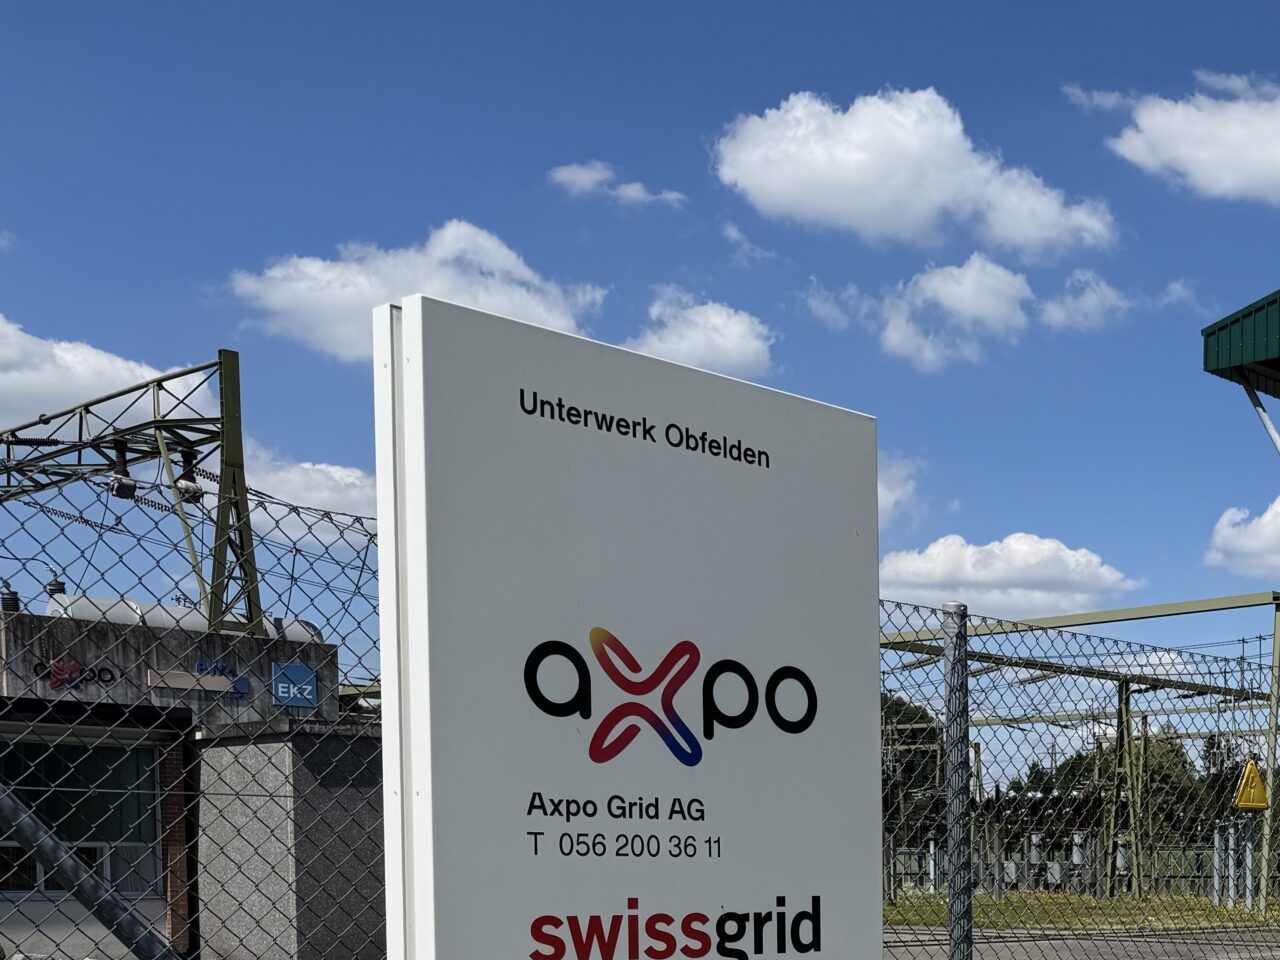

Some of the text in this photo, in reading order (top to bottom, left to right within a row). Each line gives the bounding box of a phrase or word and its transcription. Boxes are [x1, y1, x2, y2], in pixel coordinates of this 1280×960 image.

[520, 389, 770, 468] Unterwerk Obfelden
[278, 683, 313, 699] EKZ
[524, 627, 817, 767] axpo
[527, 792, 705, 822] Axpo Grid AG
[527, 832, 721, 858] T 056 200 36 11
